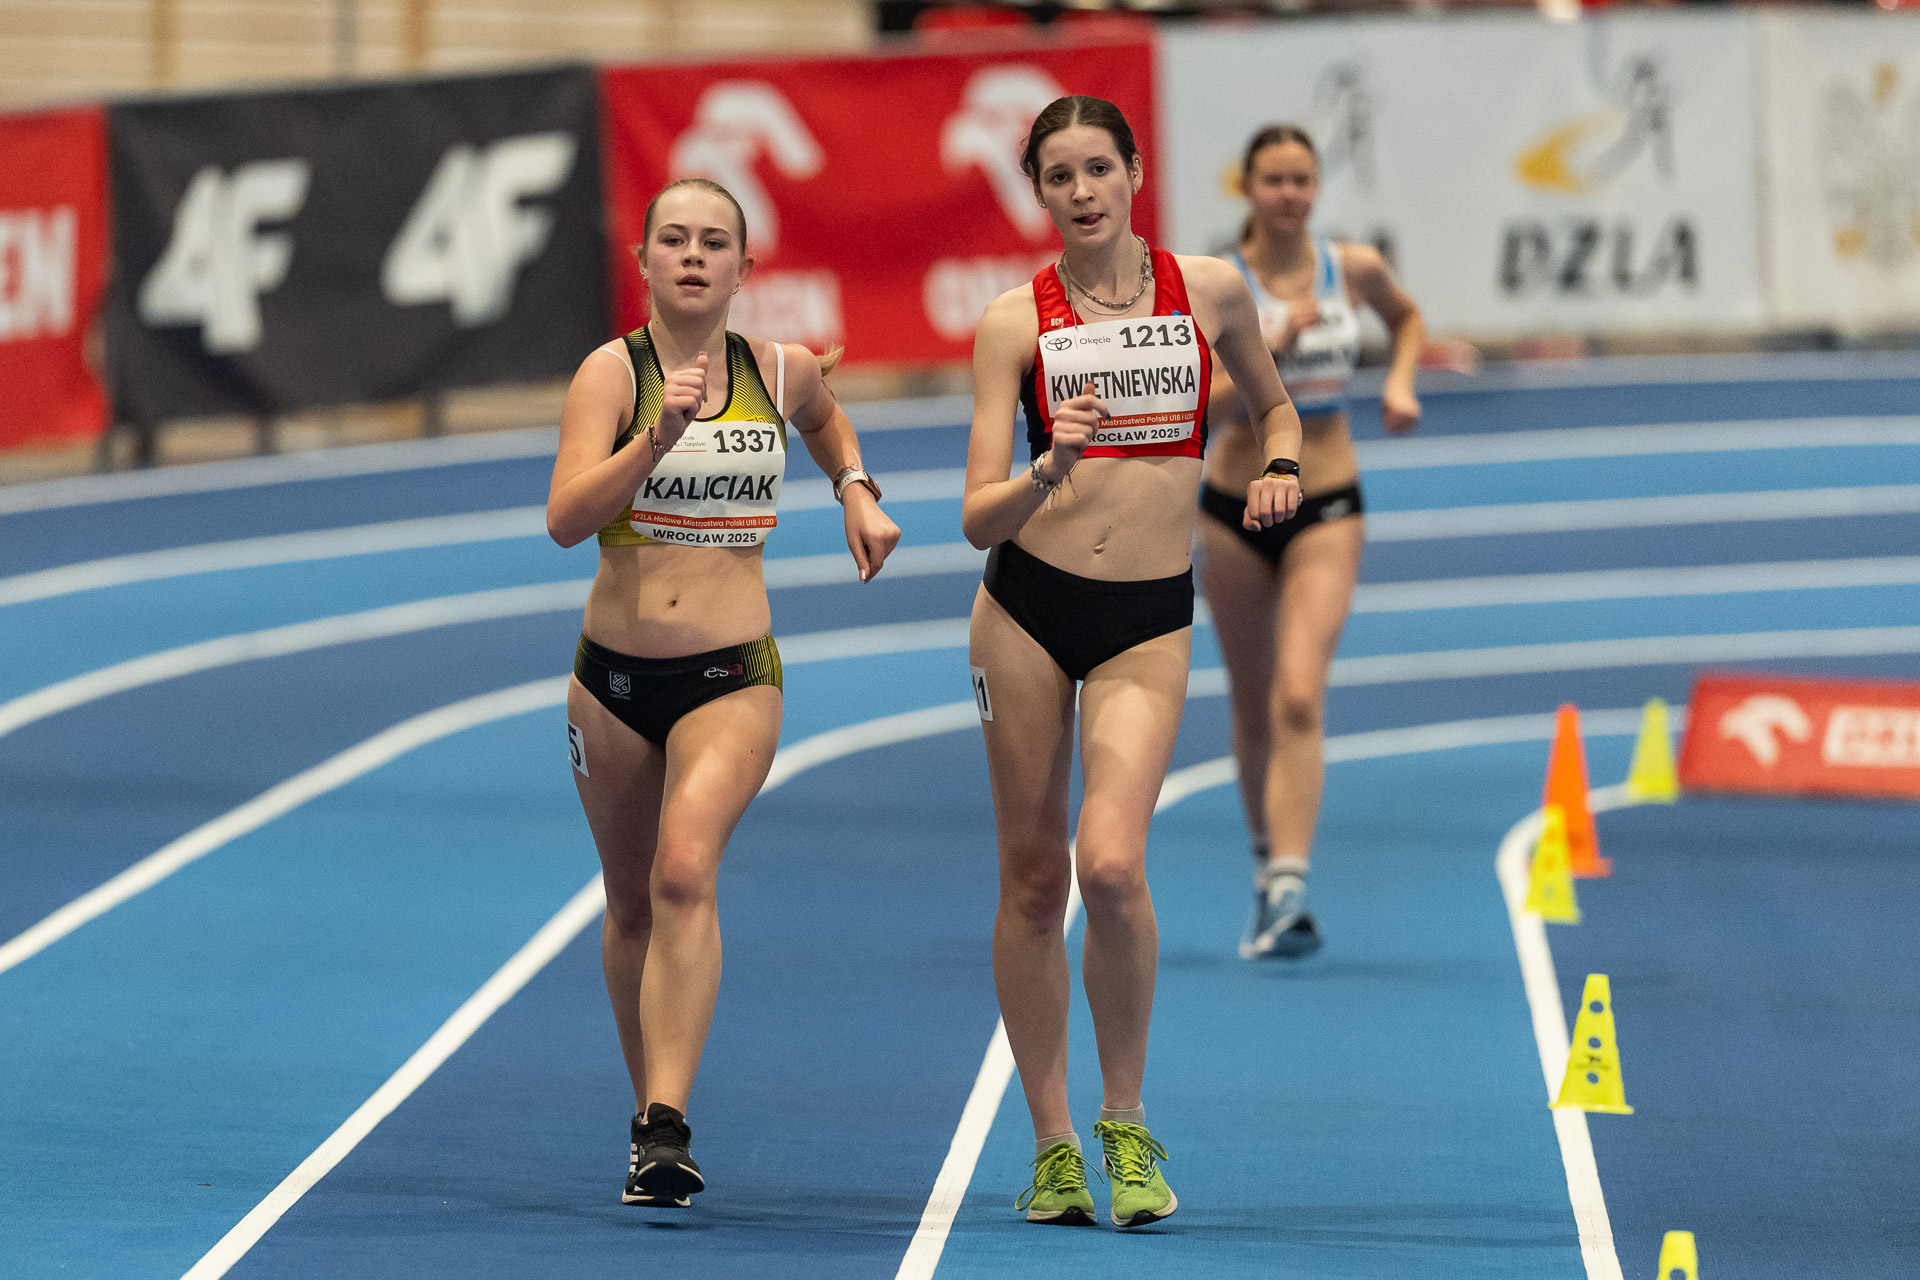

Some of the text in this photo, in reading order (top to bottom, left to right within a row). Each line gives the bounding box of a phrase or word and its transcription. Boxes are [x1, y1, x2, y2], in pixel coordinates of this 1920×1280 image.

[382, 131, 578, 327] 4F
[138, 157, 312, 354] 4F
[1500, 214, 1699, 294] DZLA
[1079, 335, 1111, 346] Okęcie
[1119, 323, 1192, 349] 1213
[1101, 417, 1145, 426] Mistrzostwa
[1146, 415, 1168, 423] Polski
[1184, 412, 1194, 420] U20
[713, 429, 776, 454] 1337
[1089, 427, 1180, 443] OCŁAW 2025
[643, 474, 777, 502] KALICIAK
[635, 512, 652, 522] PZLA
[653, 514, 682, 525] Halowe
[683, 518, 724, 528] Mistrzostwa
[725, 518, 745, 527] Polski
[745, 518, 757, 526] U18
[761, 518, 774, 526] U20
[652, 528, 757, 544] WROCŁAW 2025
